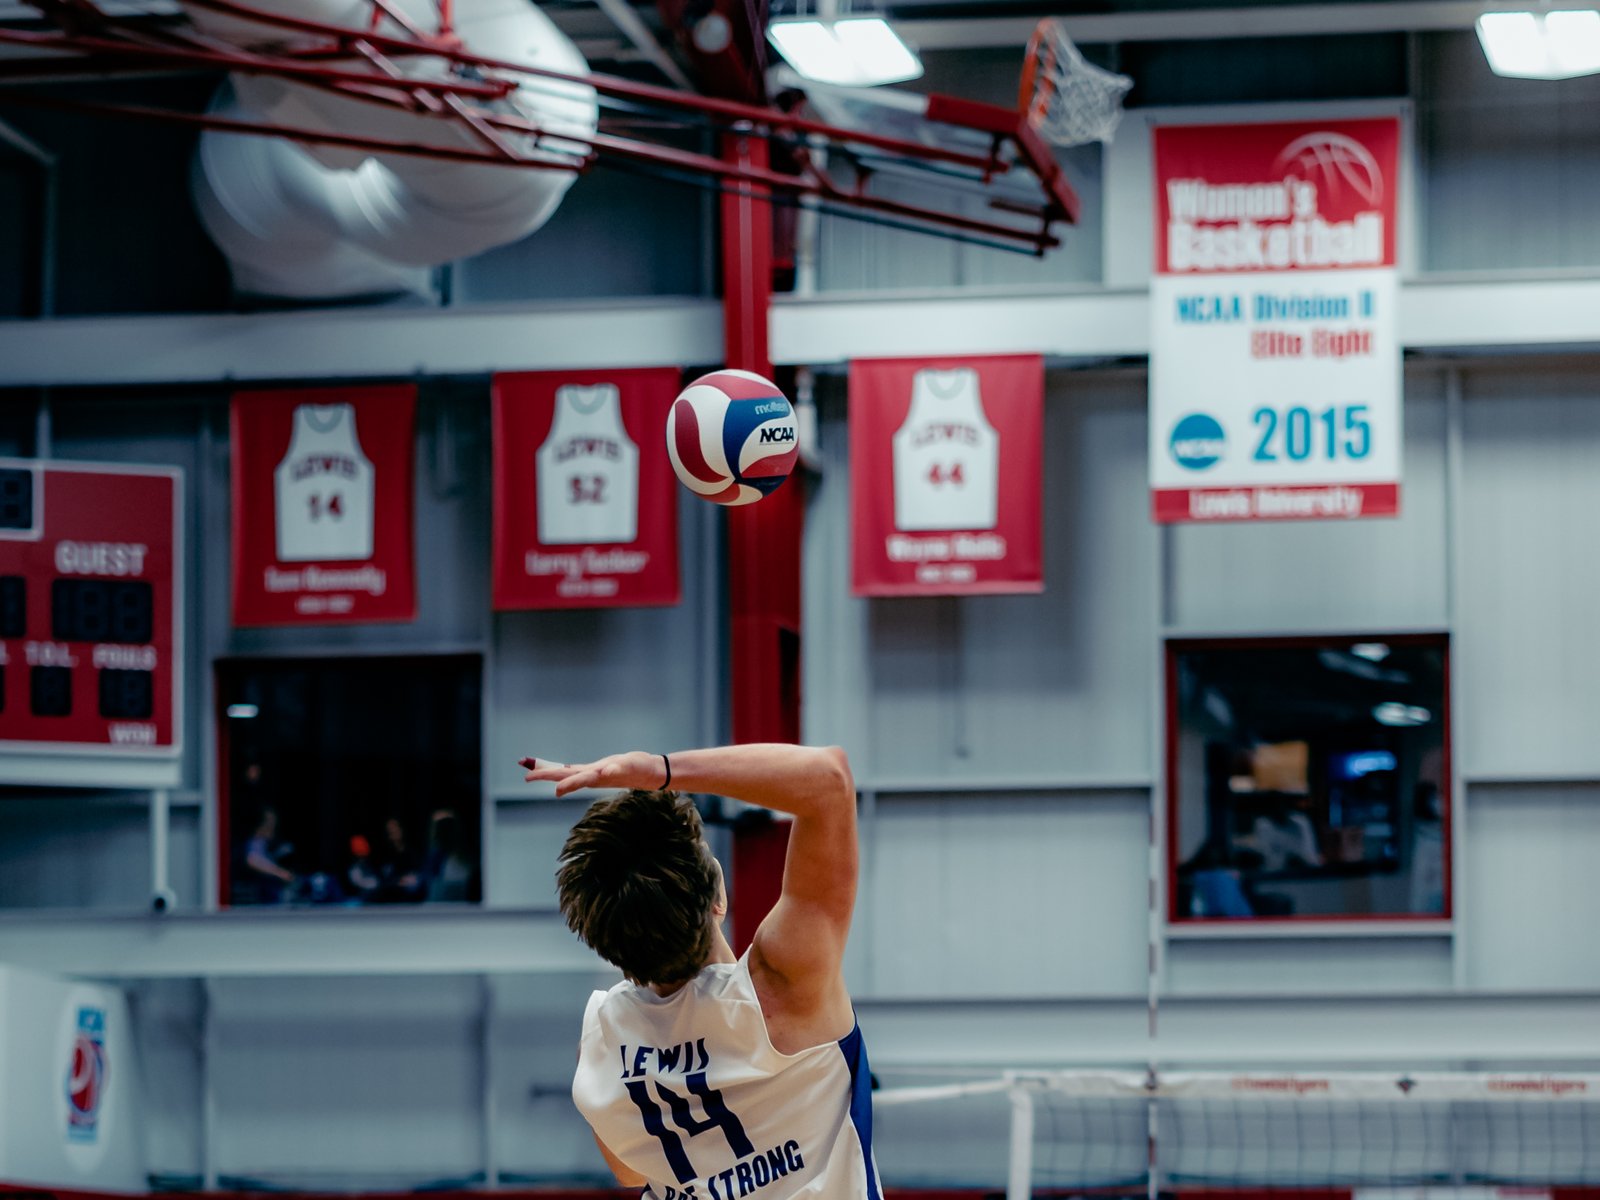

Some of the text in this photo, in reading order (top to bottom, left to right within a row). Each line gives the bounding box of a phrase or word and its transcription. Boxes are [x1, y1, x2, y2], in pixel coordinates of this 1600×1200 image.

[1169, 212, 1384, 269] Basketball
[1175, 296, 1243, 323] NCAA
[1253, 295, 1350, 321] Division
[760, 427, 794, 443] NCAA
[1253, 406, 1371, 461] 2015
[925, 462, 967, 489] 44
[55, 541, 147, 574] GUEST
[624, 1072, 755, 1184] 14
